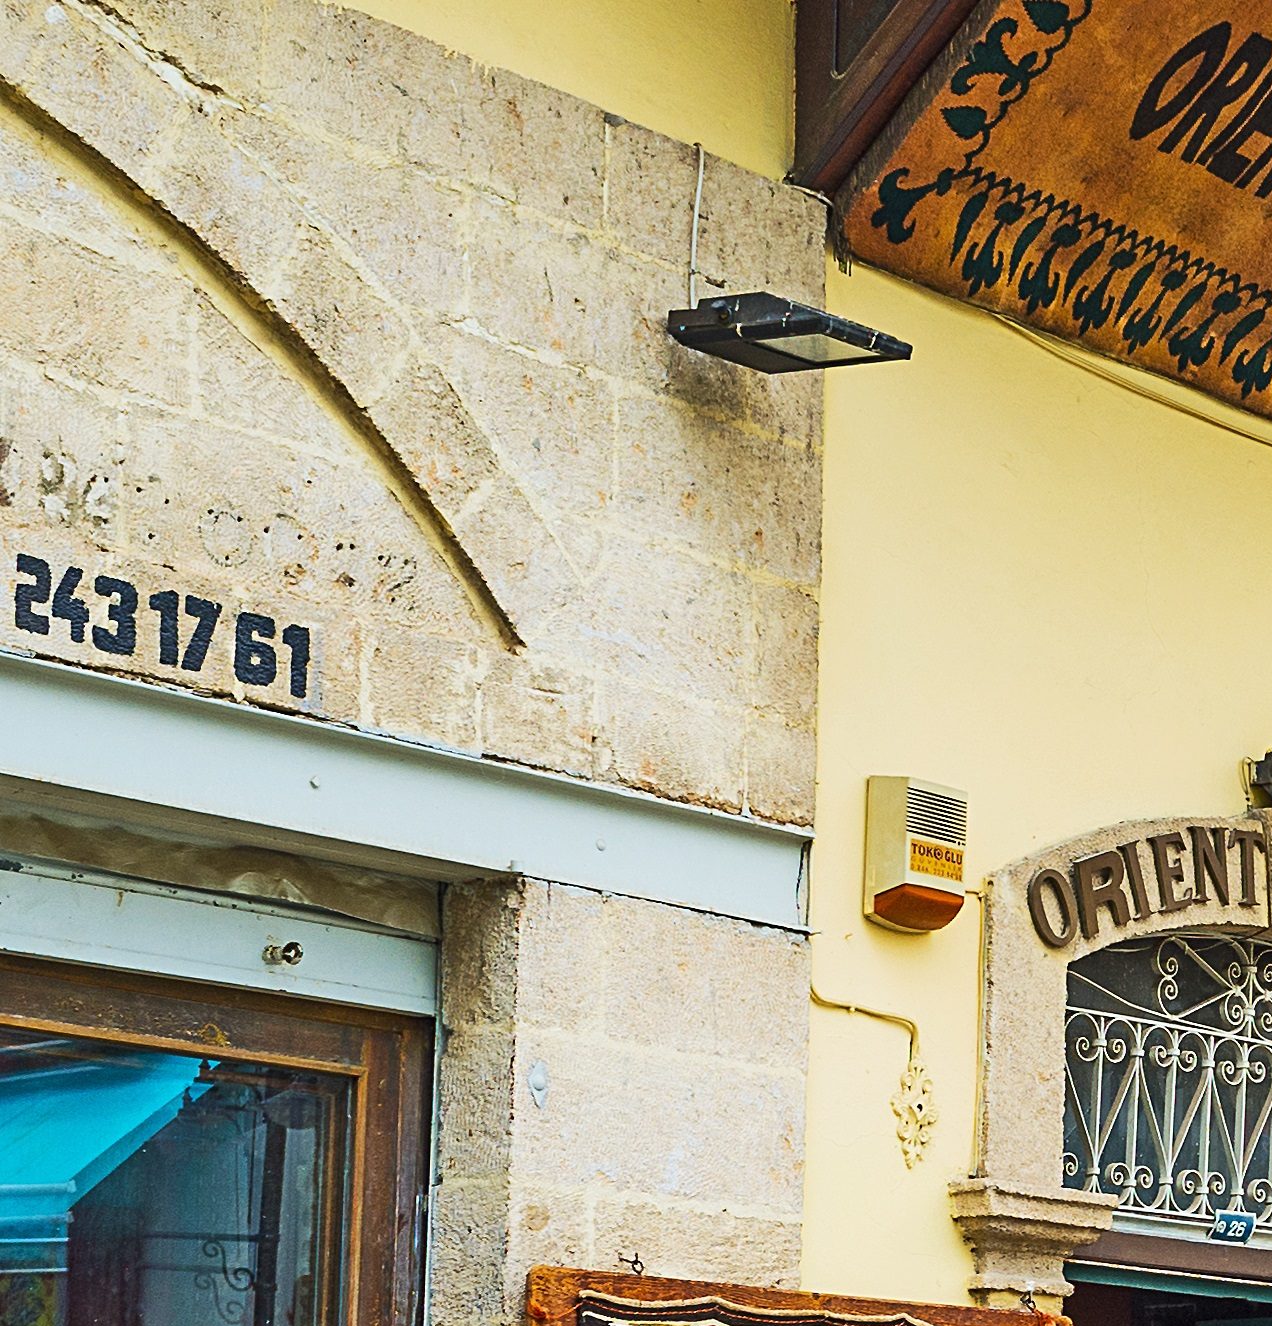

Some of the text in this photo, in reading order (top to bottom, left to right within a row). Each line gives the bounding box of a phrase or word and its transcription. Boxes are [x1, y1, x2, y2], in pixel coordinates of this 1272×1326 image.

[14, 552, 311, 699] 243 17 61
[1027, 825, 1266, 950] ORIENT
